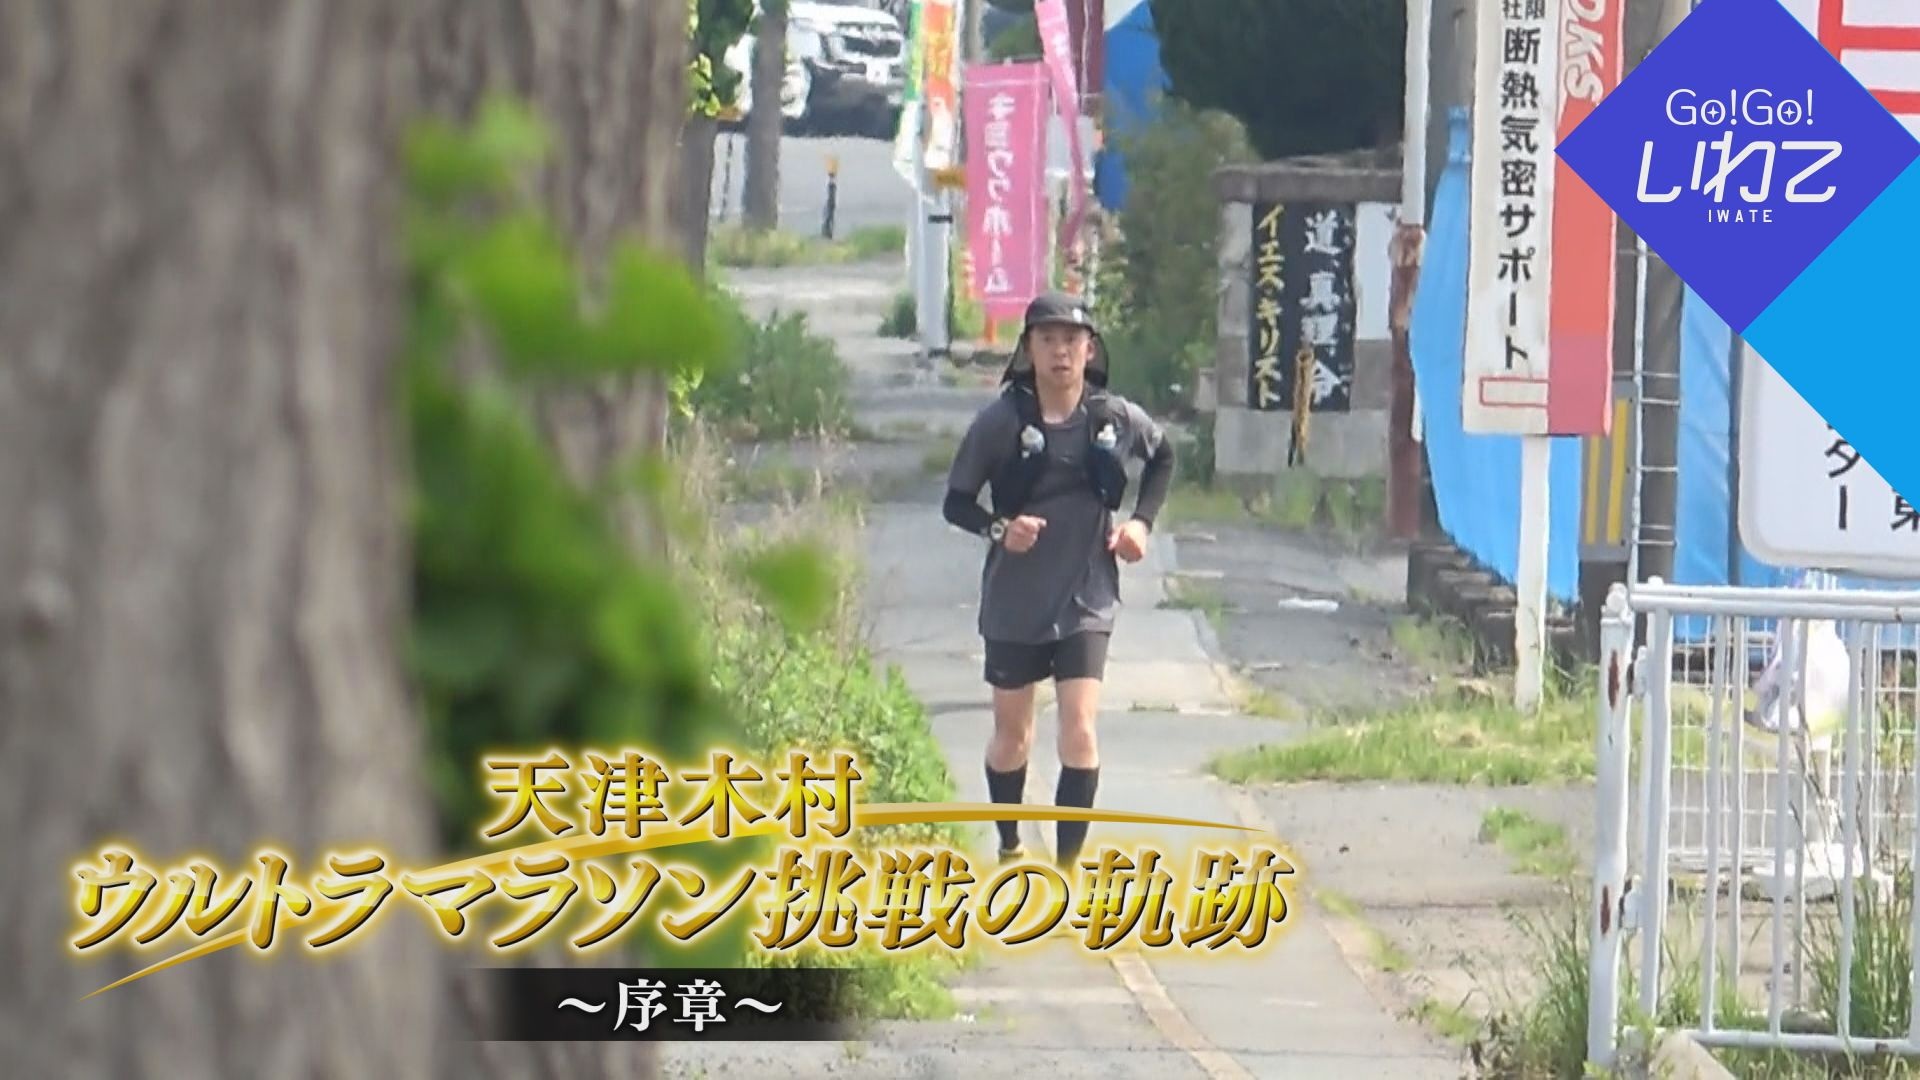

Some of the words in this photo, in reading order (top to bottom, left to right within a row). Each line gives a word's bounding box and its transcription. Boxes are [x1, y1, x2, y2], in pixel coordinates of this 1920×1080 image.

[1499, 27, 1541, 371] 断熱気密サポート
